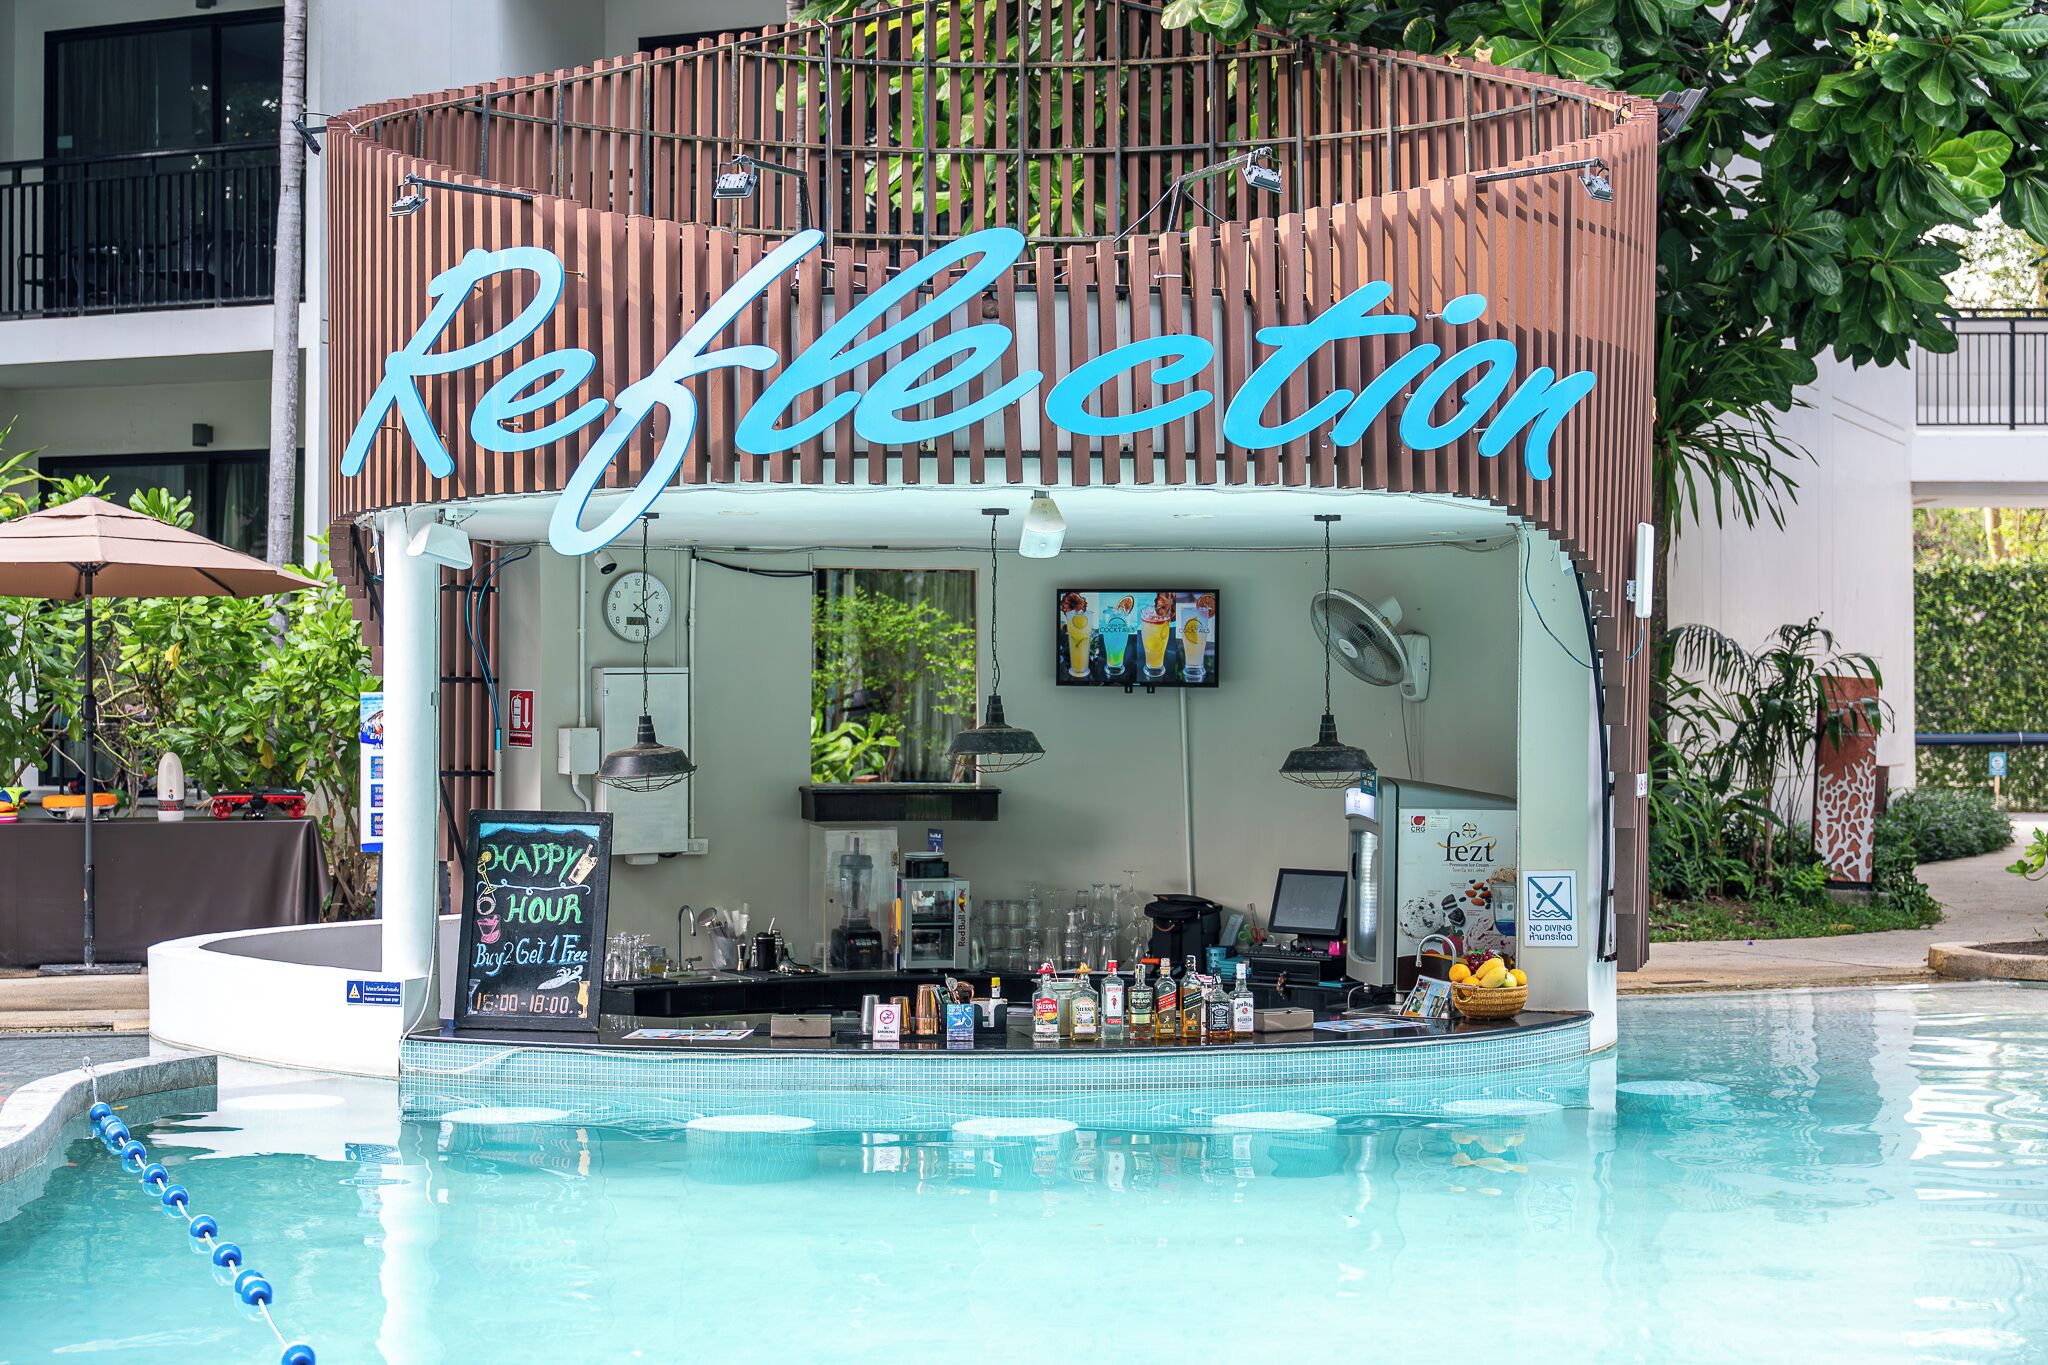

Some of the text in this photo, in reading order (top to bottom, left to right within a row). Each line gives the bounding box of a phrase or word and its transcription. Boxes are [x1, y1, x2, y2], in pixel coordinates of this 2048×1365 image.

[341, 227, 1595, 555] Reflection
[485, 843, 586, 882] HAPPY
[1444, 831, 1495, 862] fezt
[503, 894, 583, 926] HOUR
[957, 914, 966, 947] Red Bull
[1529, 924, 1573, 932] NO DIVING
[1529, 931, 1573, 941] ห้ามกระโดด
[474, 934, 589, 976] Buy 2 Get 1 Free
[1036, 1002, 1056, 1010] SIERRA
